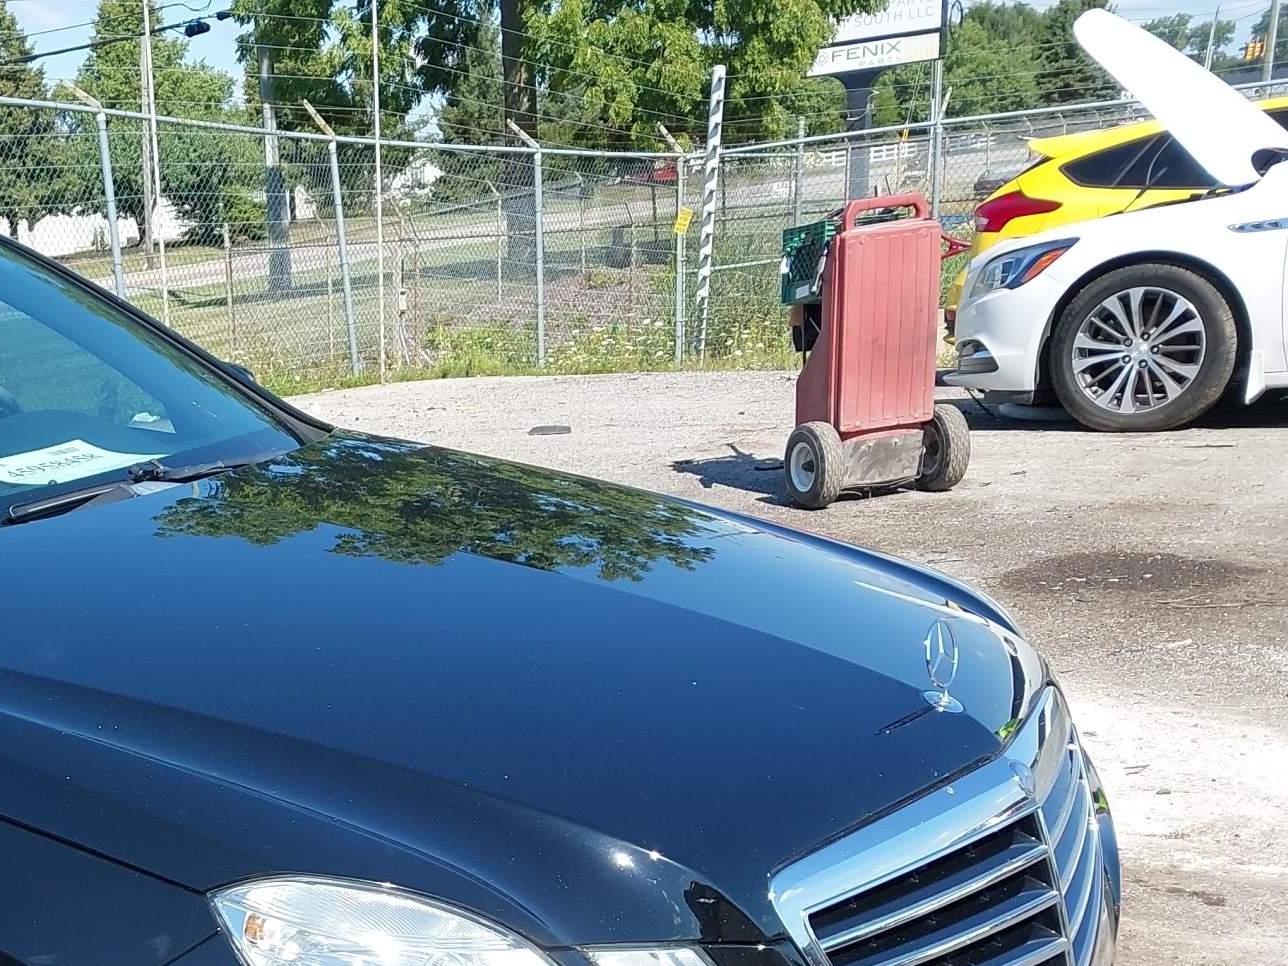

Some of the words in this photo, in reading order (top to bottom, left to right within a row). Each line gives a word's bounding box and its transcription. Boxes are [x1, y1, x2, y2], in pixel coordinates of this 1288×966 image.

[854, 9, 903, 28] SOUTH
[908, 5, 936, 20] LLC
[831, 40, 902, 63] FENIX
[858, 55, 903, 67] PARTS
